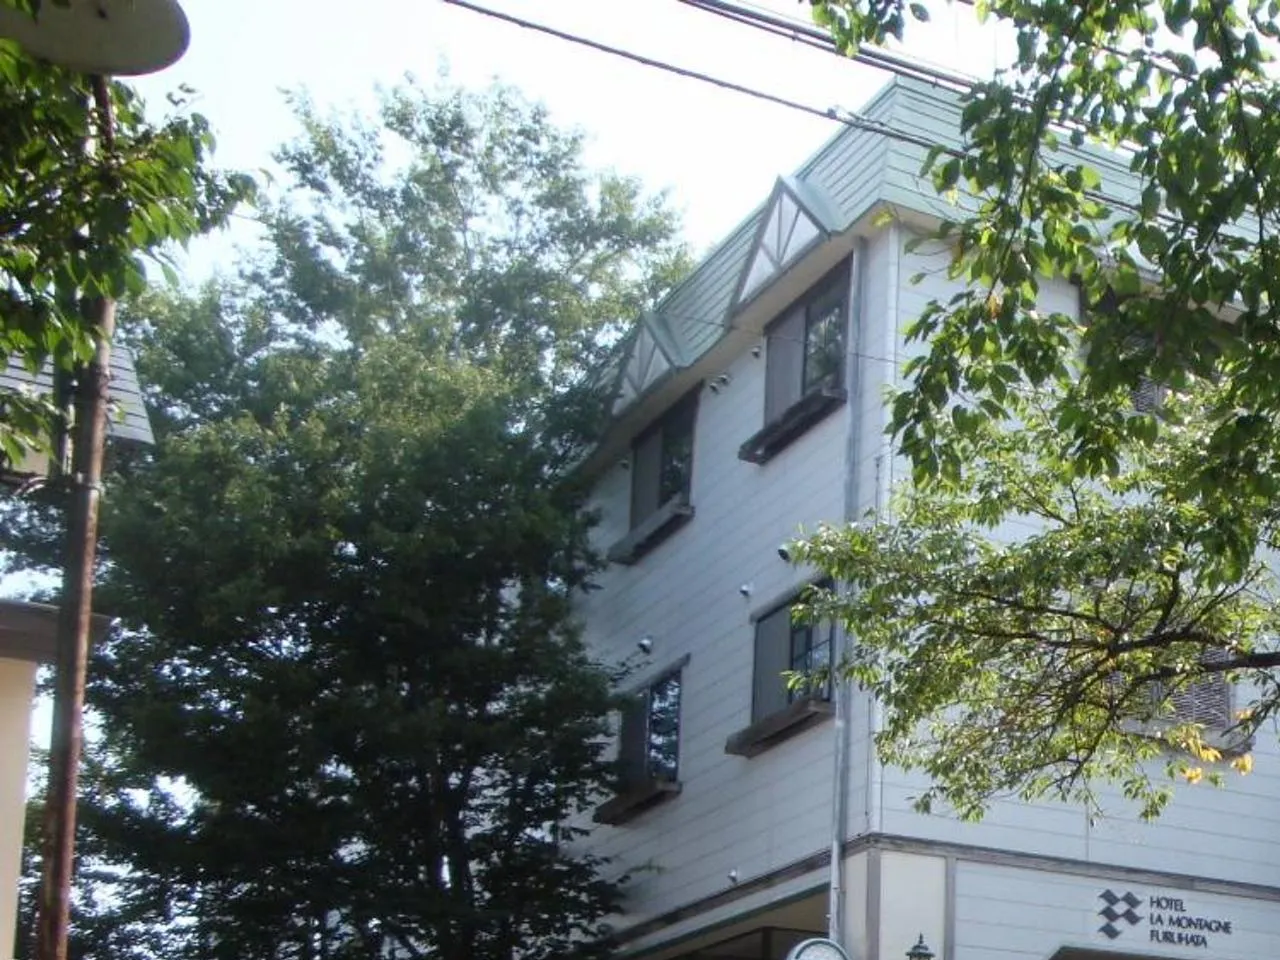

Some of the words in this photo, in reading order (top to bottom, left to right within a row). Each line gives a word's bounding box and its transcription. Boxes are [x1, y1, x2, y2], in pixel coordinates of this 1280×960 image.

[1150, 896, 1186, 912] HOTEL
[1150, 914, 1163, 925] LA
[1169, 915, 1232, 934] MONTAGNE
[1150, 930, 1207, 948] FURUHATA
